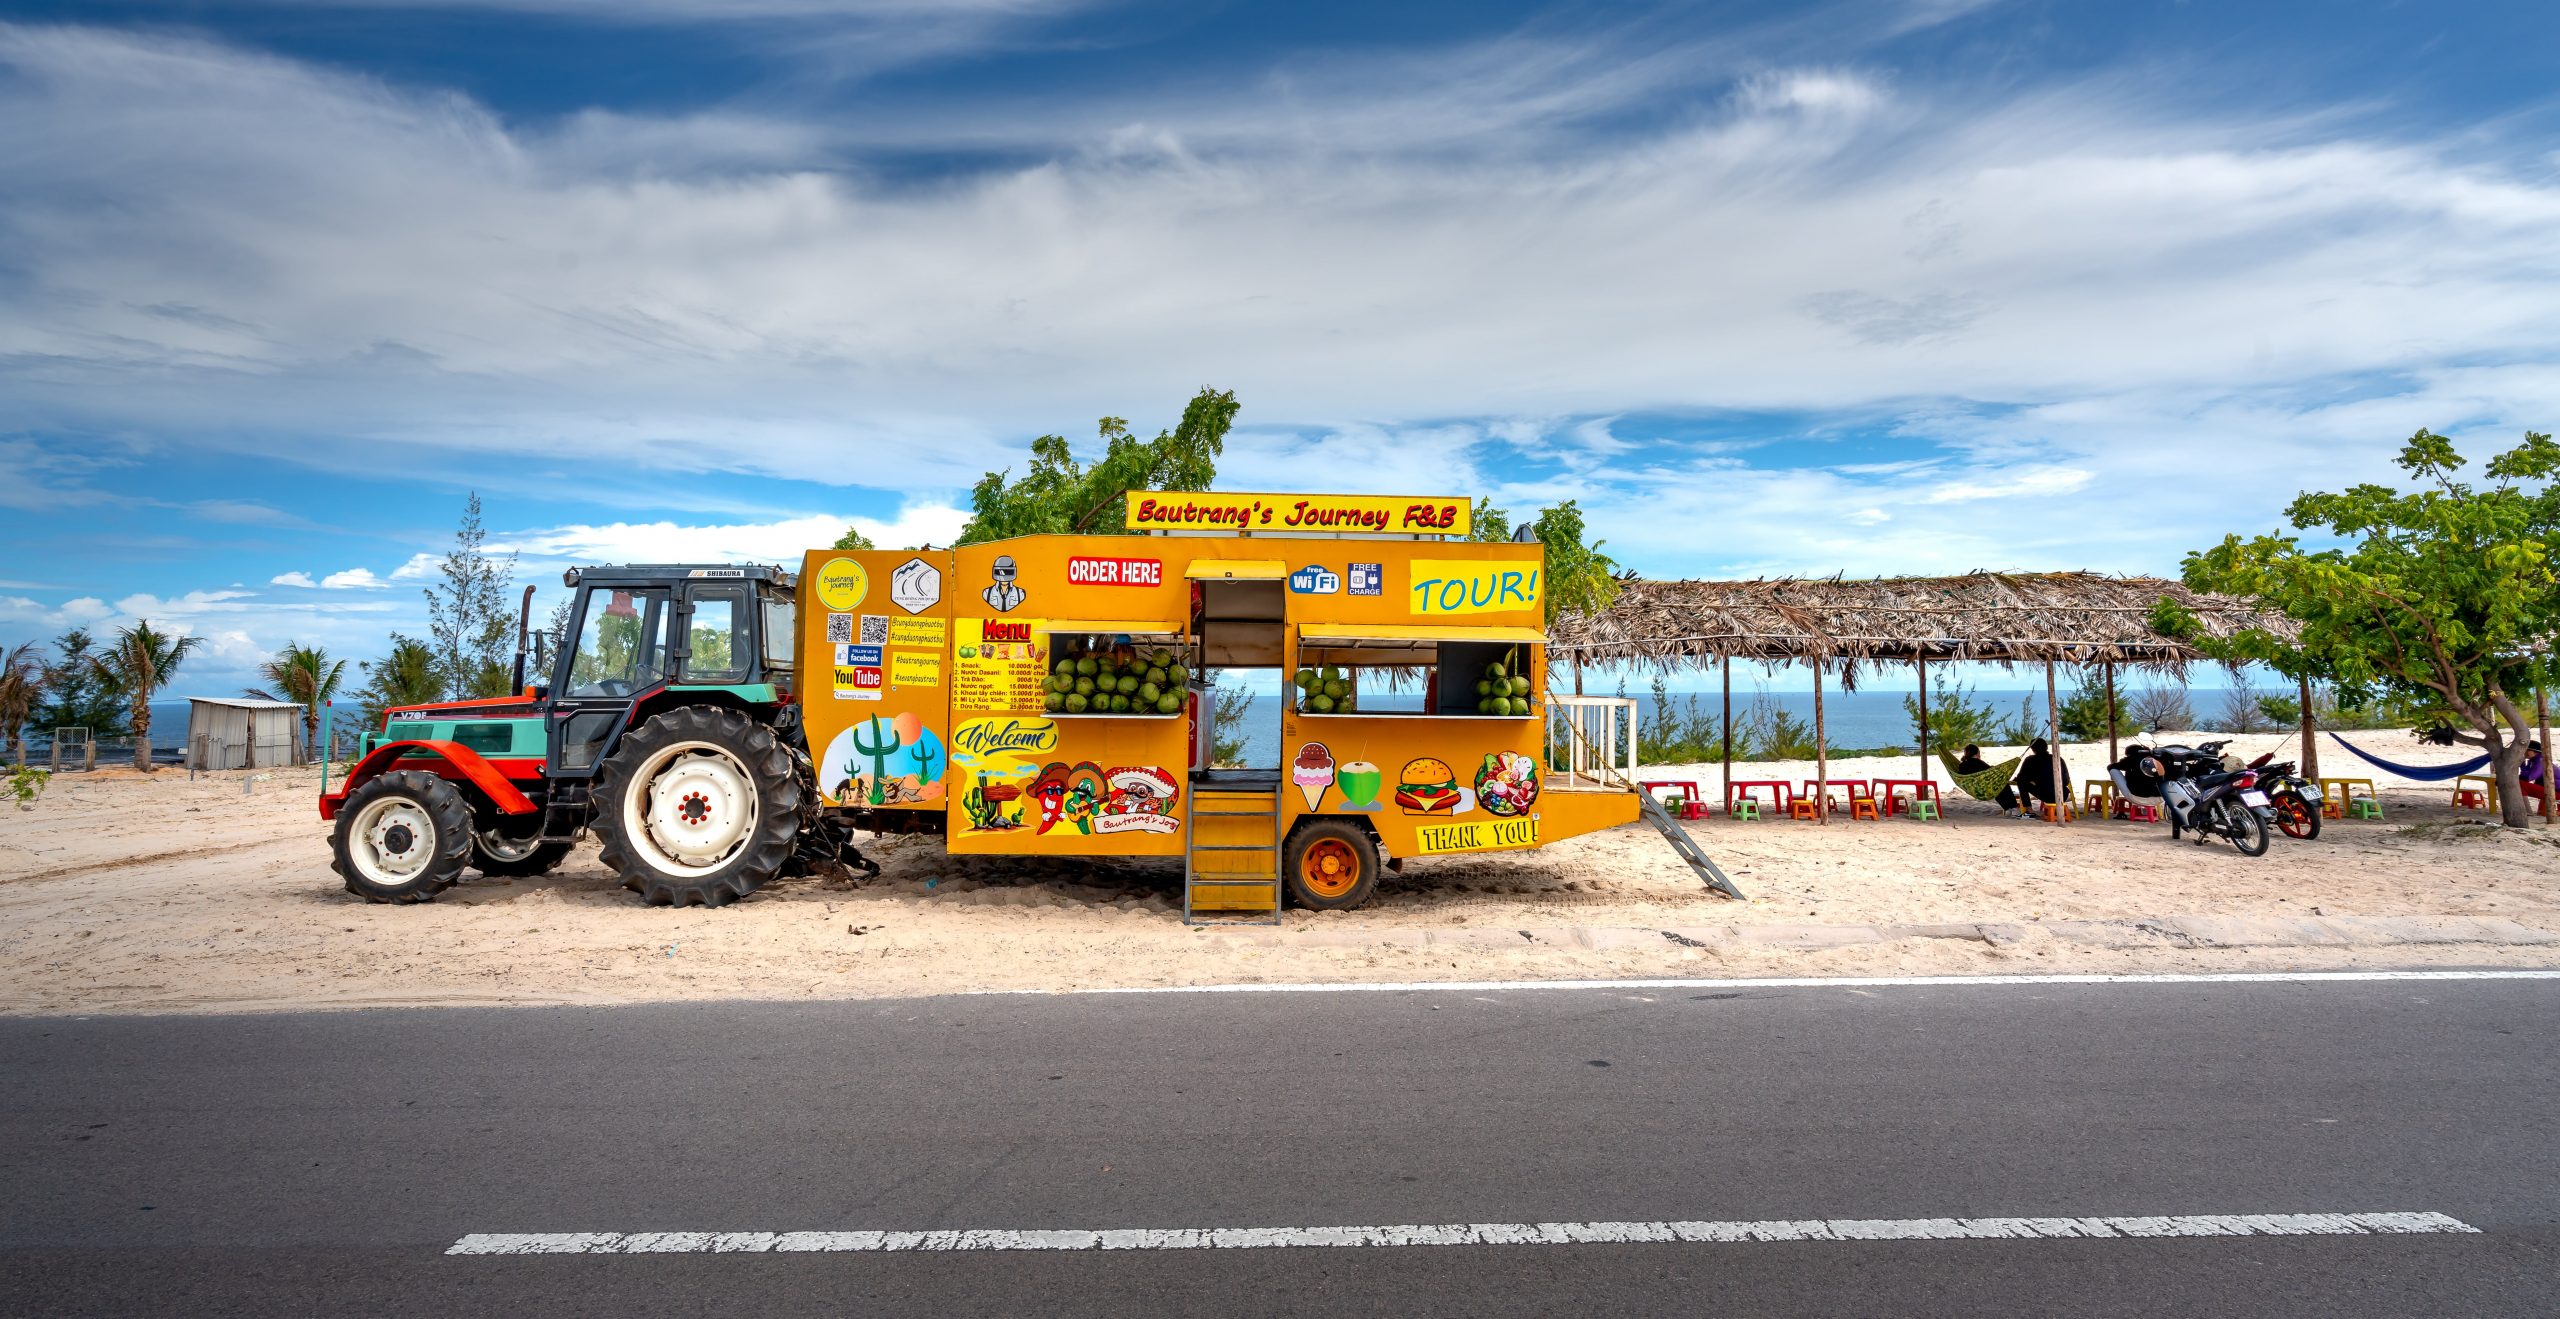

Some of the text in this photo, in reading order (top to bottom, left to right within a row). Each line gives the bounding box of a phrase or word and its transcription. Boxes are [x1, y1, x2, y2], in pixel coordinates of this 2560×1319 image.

[1137, 499, 1457, 530] Bautrang's Journey F&B
[1070, 560, 1161, 584] ORDER HERE
[1353, 563, 1377, 571] FREE
[824, 574, 860, 584] Bautrang's
[1414, 570, 1538, 612] TOUR!
[982, 618, 1032, 641] Menu
[850, 653, 879, 663] facebook
[834, 669, 881, 686] YouTube
[955, 720, 1057, 756] Welcome
[1103, 814, 1157, 829] Bautrang's
[1423, 820, 1539, 851] THANK YOU!
